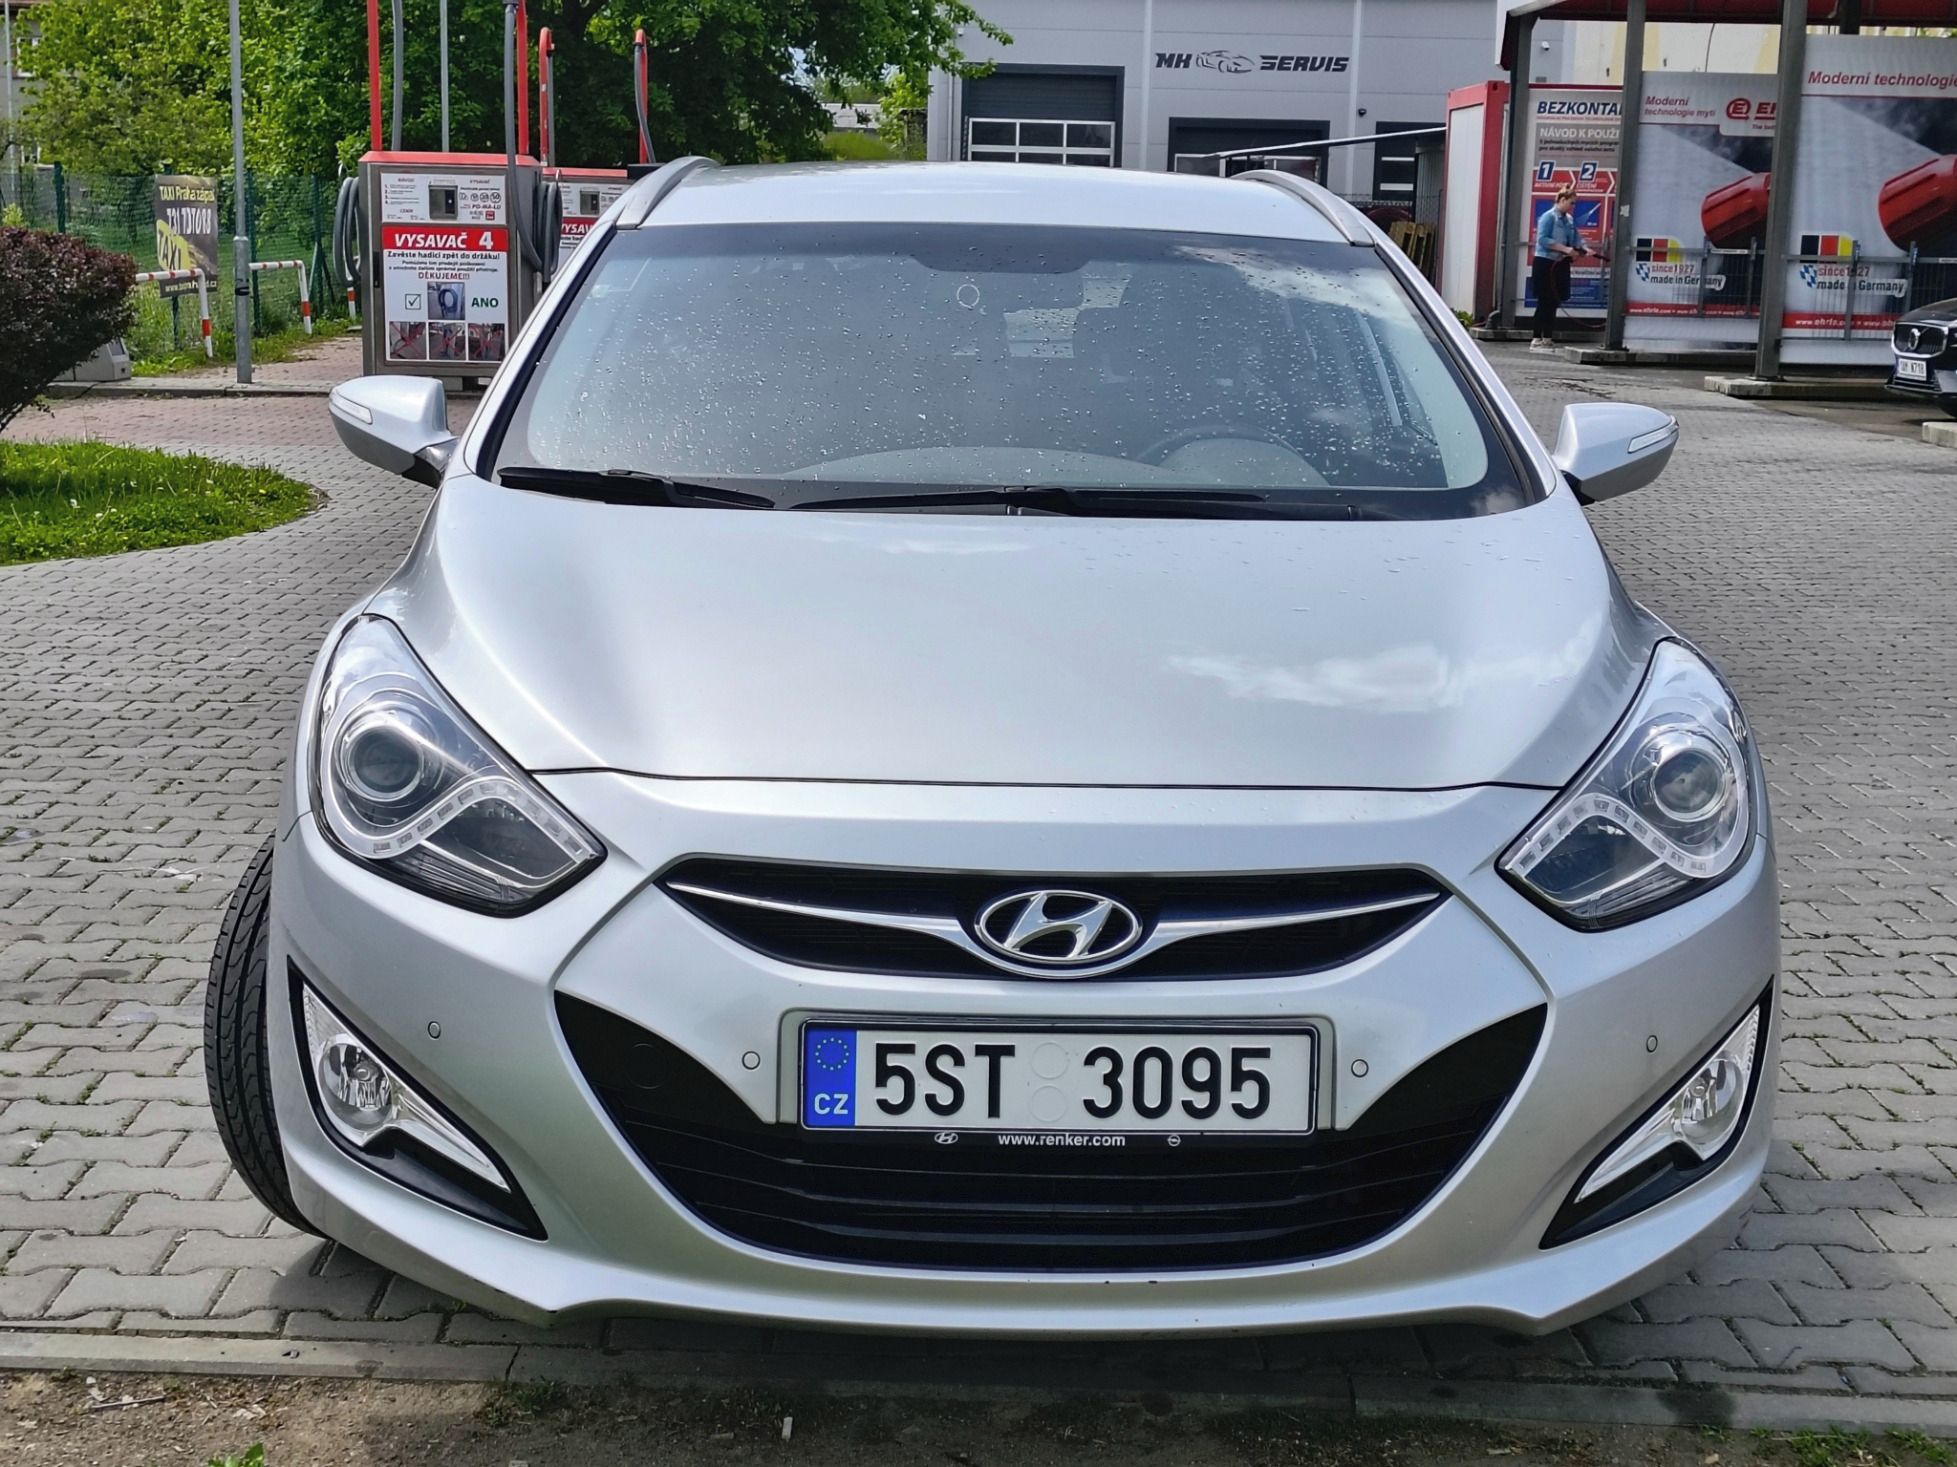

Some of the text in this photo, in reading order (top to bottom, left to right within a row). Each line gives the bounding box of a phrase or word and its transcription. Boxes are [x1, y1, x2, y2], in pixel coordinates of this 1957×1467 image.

[1155, 53, 1350, 72] MH SERVIS
[1540, 126, 1577, 138] NÁVOD
[1579, 129, 1585, 138] K
[1542, 164, 1593, 179] 1 2
[159, 185, 175, 200] TAXI
[395, 231, 494, 250] VYSAVAČ 4
[1650, 275, 1674, 284] made
[1675, 275, 1684, 284] in
[1817, 279, 1846, 290] made
[1858, 280, 1905, 295] Germany
[471, 297, 499, 308] ANO
[875, 1042, 1272, 1120] 5ST 3095
[814, 1093, 849, 1115] CZ
[998, 1133, 1126, 1147] www.renker.com
